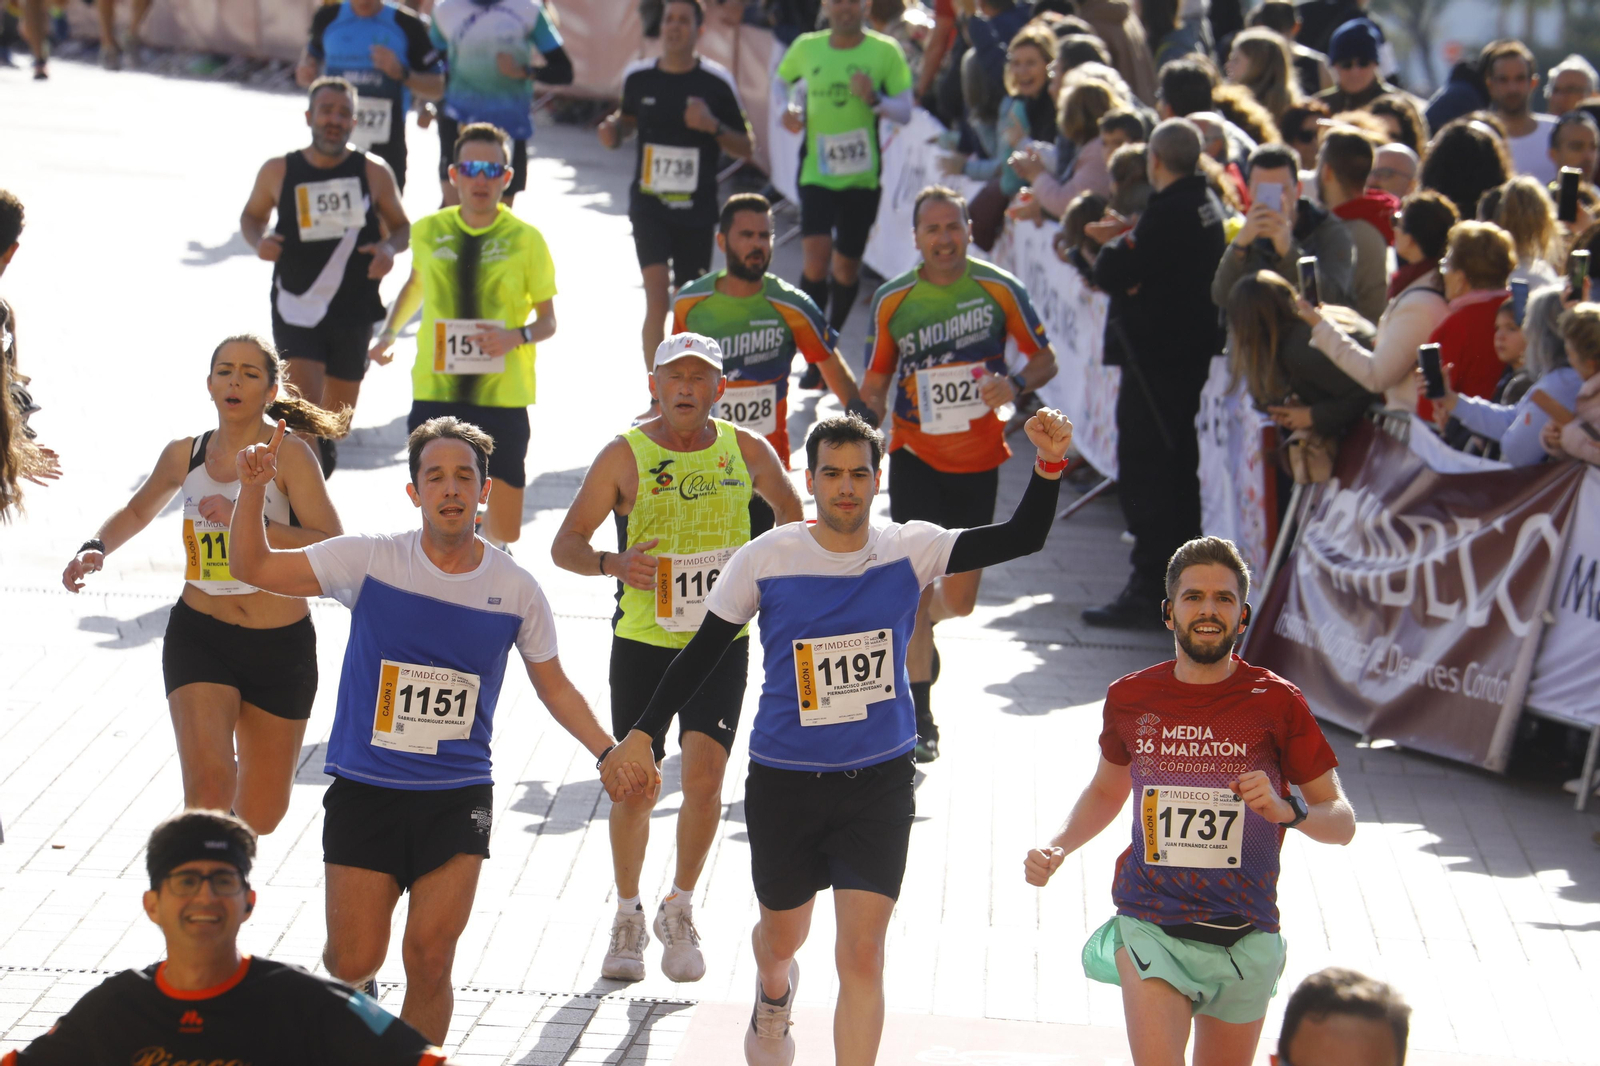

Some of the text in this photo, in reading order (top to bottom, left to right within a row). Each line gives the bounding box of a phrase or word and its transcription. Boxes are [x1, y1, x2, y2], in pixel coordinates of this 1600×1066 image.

[654, 158, 694, 179] 1738
[317, 192, 352, 212] 591
[918, 304, 994, 351] MOJAMAS
[448, 334, 484, 355] 15
[721, 398, 772, 423] 3028
[201, 532, 227, 559] 11
[683, 556, 716, 566] IMDECO
[675, 569, 721, 598] 116
[824, 639, 862, 651] IMDECO
[411, 670, 449, 681] IMDECO
[818, 649, 886, 686] 1197
[802, 669, 812, 696] CAJÓN
[827, 684, 882, 696] PIERNAGORDA POVEDANO
[1462, 661, 1510, 706] Córdo
[382, 689, 392, 717] CAJÓN
[399, 684, 468, 717] 1151
[397, 715, 416, 723] GABRIEL
[1162, 725, 1214, 740] MEDIA
[1135, 737, 1247, 757] 36 MARATÓN
[1159, 760, 1247, 773] CÓRDOBA 2022
[1169, 790, 1210, 801] IMDECO
[1159, 806, 1239, 841] 1737
